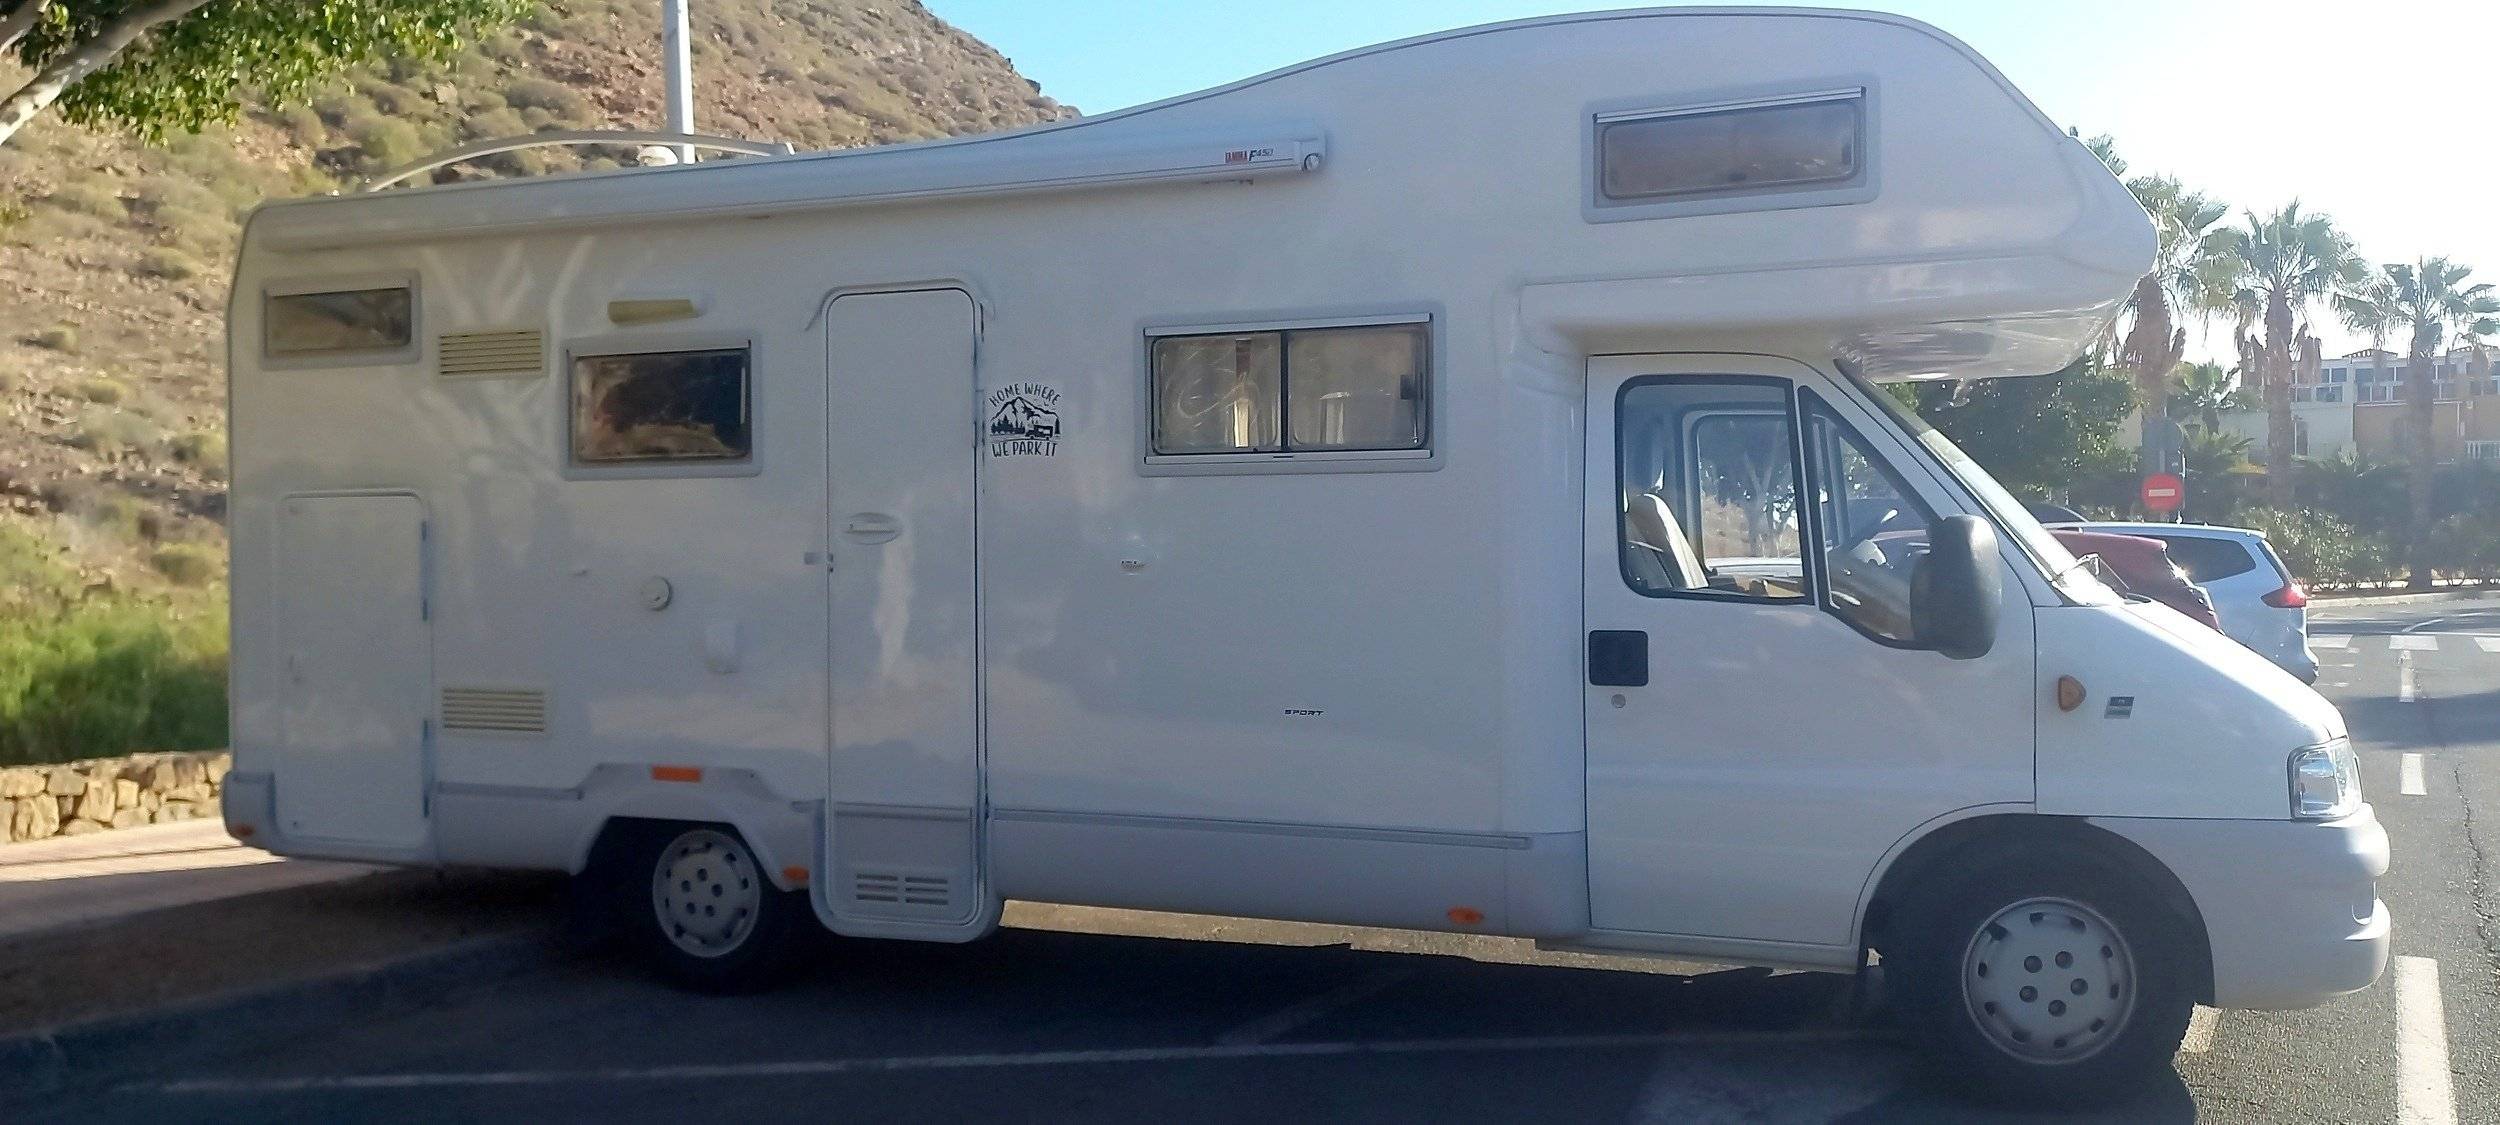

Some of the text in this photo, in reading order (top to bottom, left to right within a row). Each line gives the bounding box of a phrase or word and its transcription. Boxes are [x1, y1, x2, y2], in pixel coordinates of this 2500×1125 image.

[989, 382, 1061, 407] HOME WHERE
[992, 441, 1058, 457] WE PARK IT
